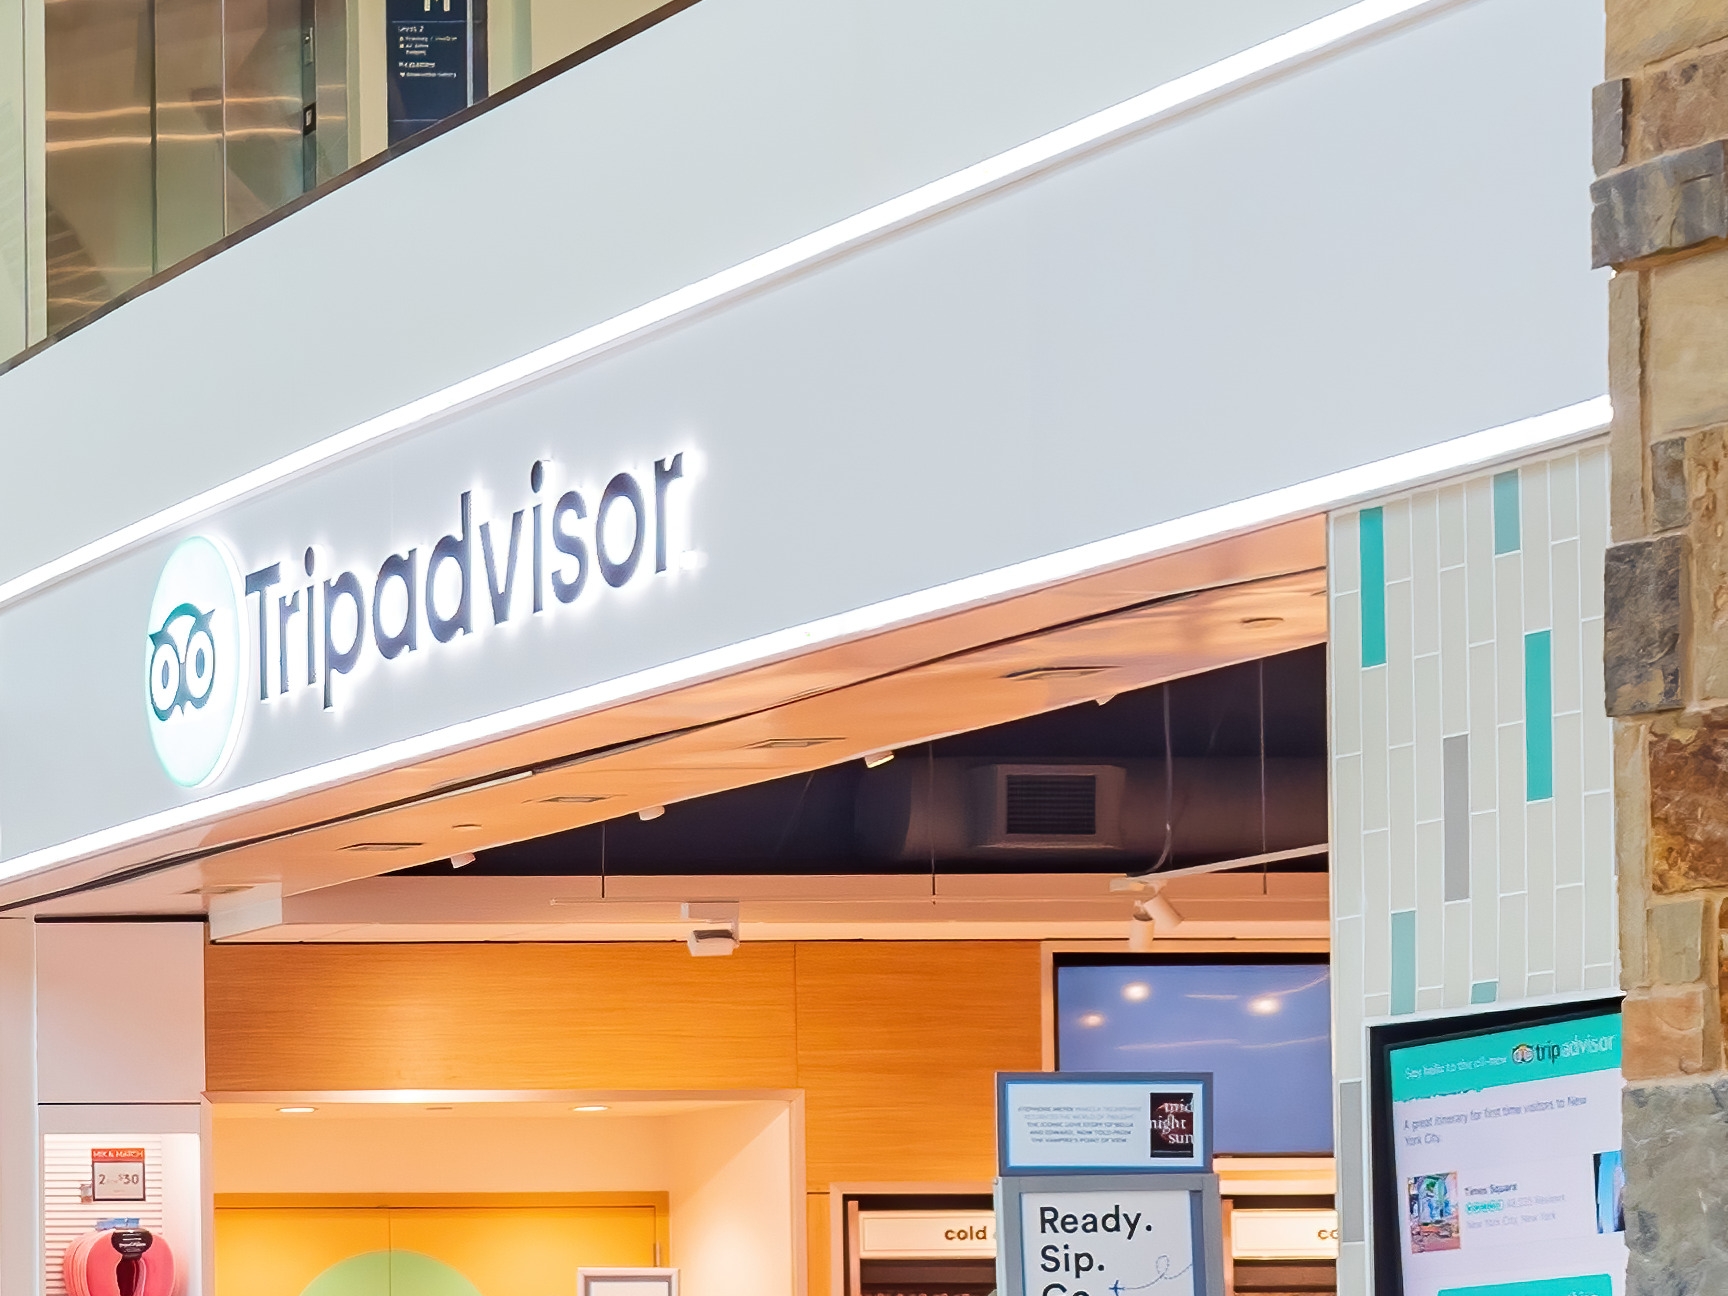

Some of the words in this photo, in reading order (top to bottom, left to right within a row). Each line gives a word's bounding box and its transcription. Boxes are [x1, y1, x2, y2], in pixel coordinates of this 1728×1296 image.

[245, 452, 684, 709] Tripadvisor
[1535, 1033, 1617, 1065] tripadvisor
[99, 1174, 105, 1184] 2
[944, 1226, 987, 1240] cold
[1040, 1204, 1152, 1240] Ready.
[1040, 1244, 1105, 1278] Sip.
